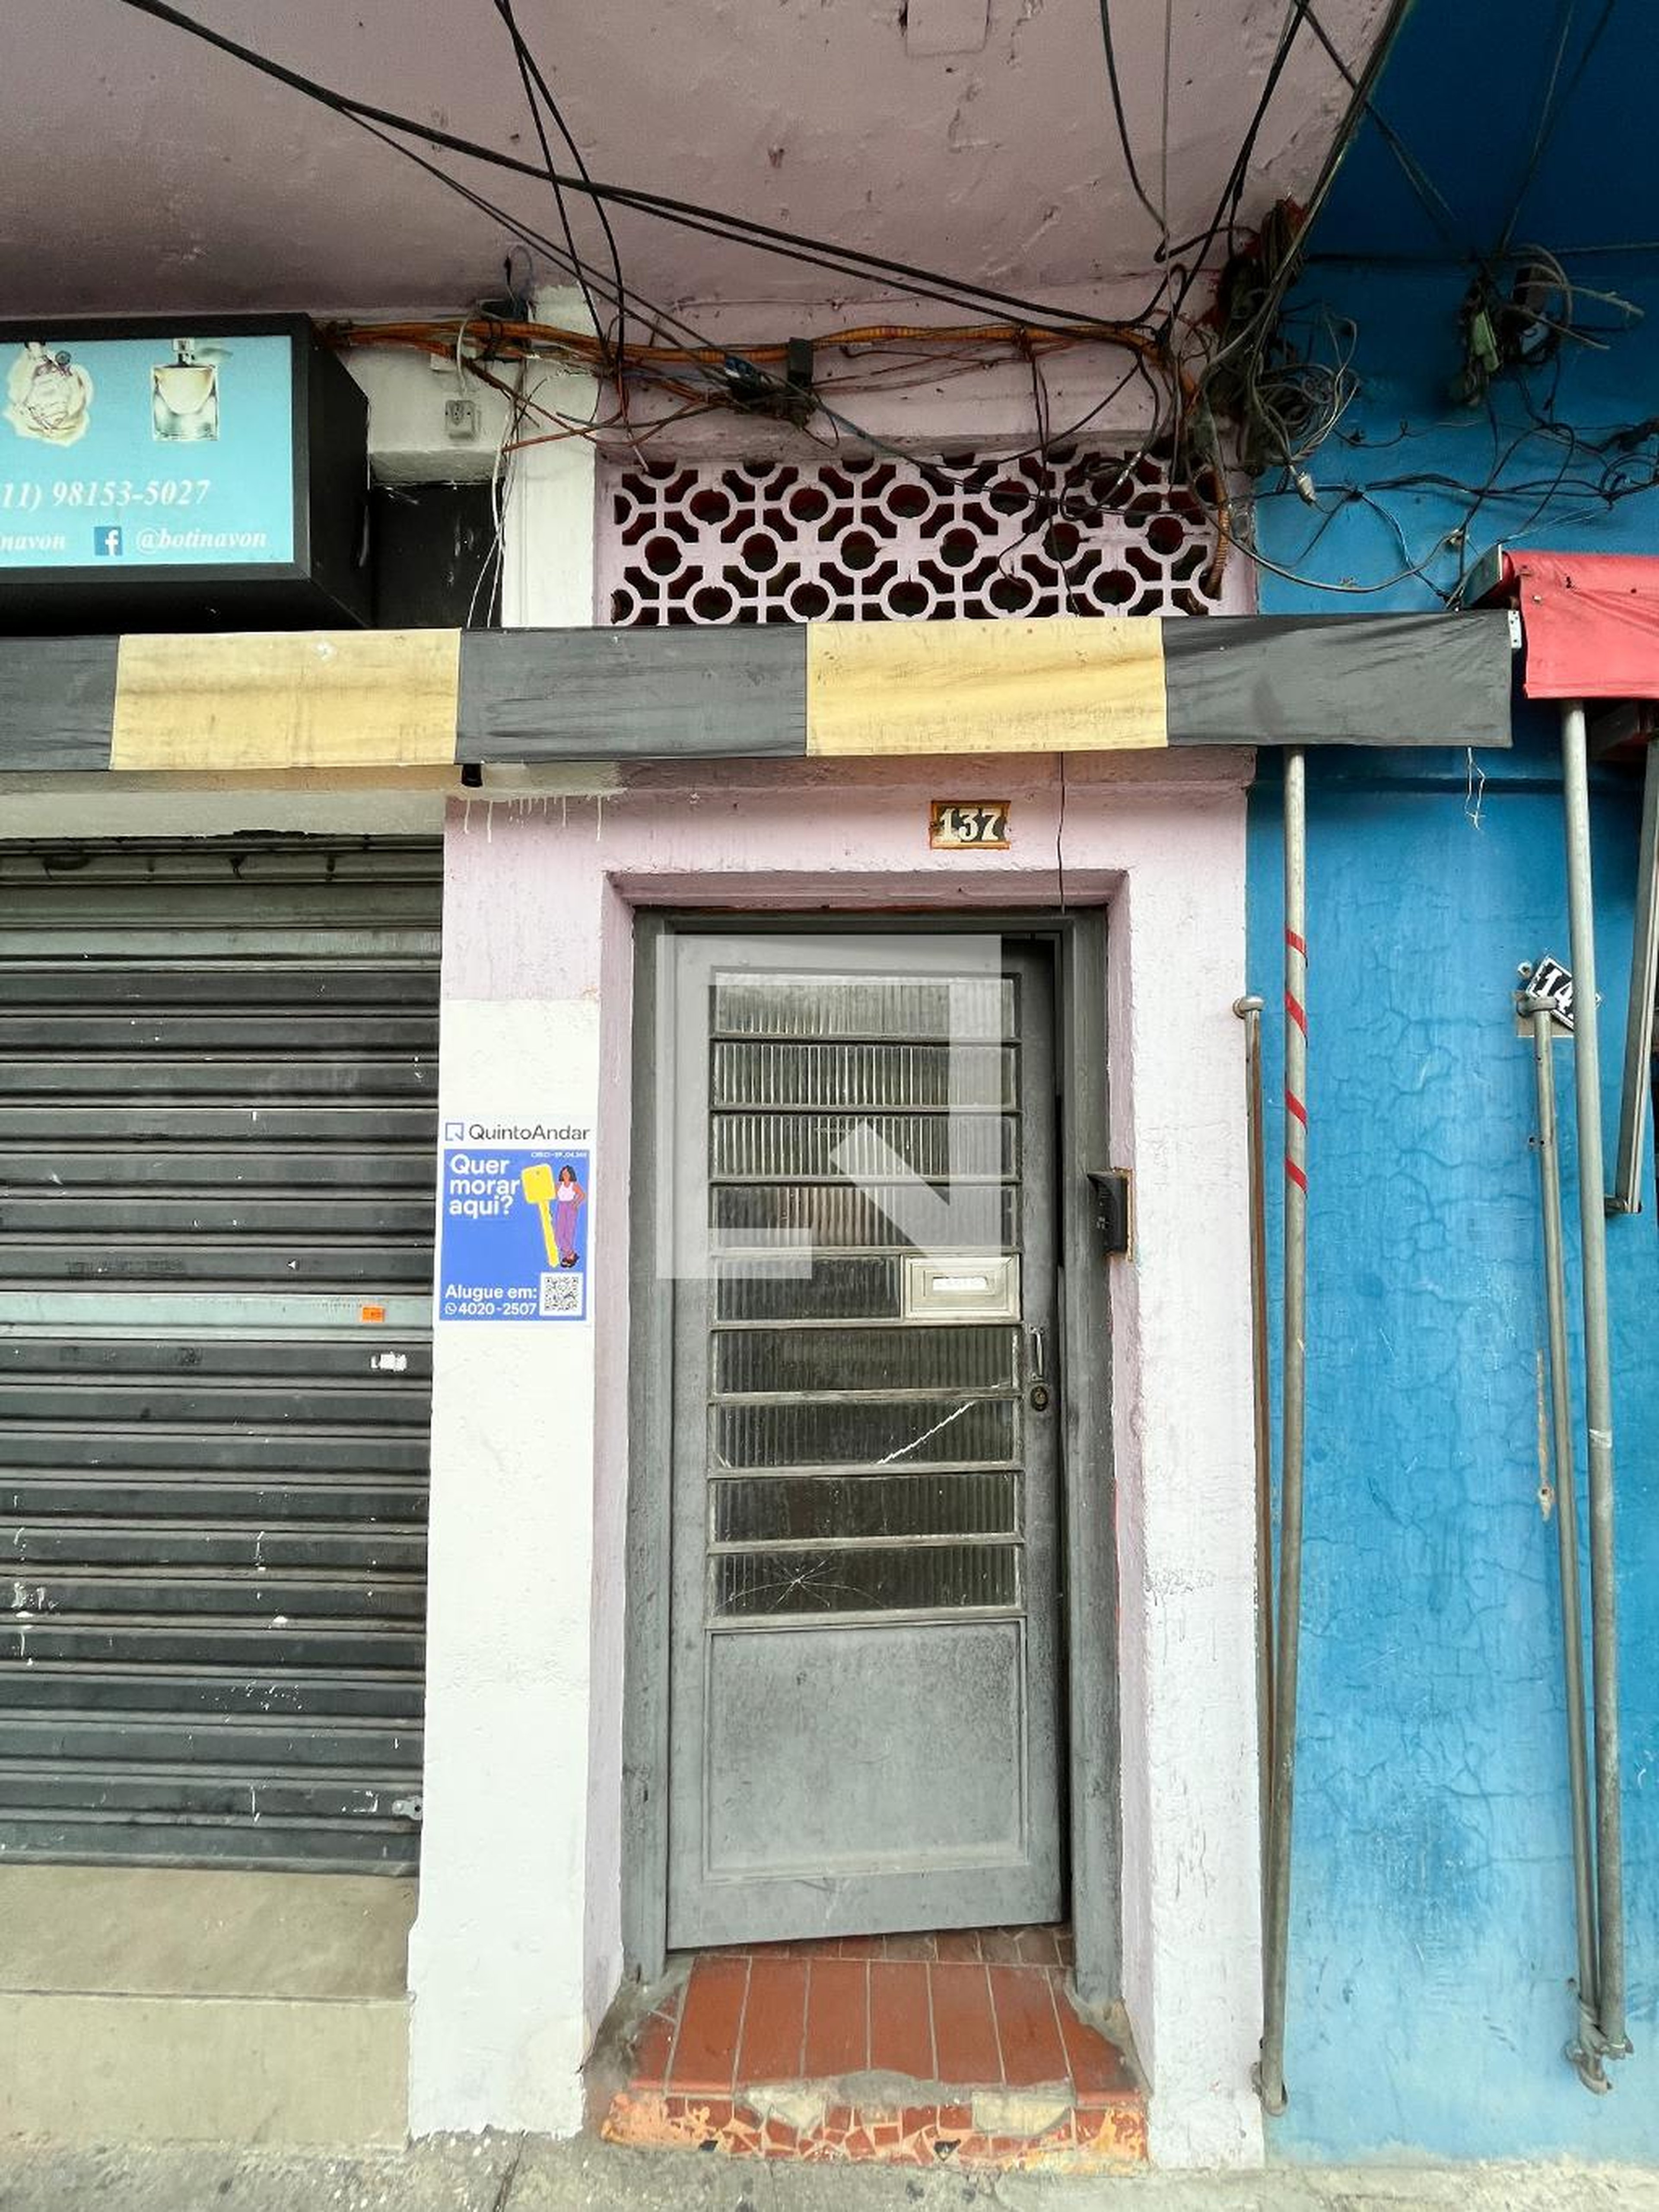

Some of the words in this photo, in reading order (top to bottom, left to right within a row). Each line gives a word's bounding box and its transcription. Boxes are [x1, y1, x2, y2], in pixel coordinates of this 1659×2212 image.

[52, 479, 211, 507] 98153-5027
[136, 527, 268, 556] @botinavon
[937, 808, 1001, 841] 137
[469, 1124, 590, 1140] QuintoAndar
[450, 1153, 510, 1175] Quer
[449, 1178, 520, 1195] morar
[449, 1195, 513, 1219] aqui?
[445, 1284, 504, 1302] Alugue
[507, 1286, 537, 1299] em:
